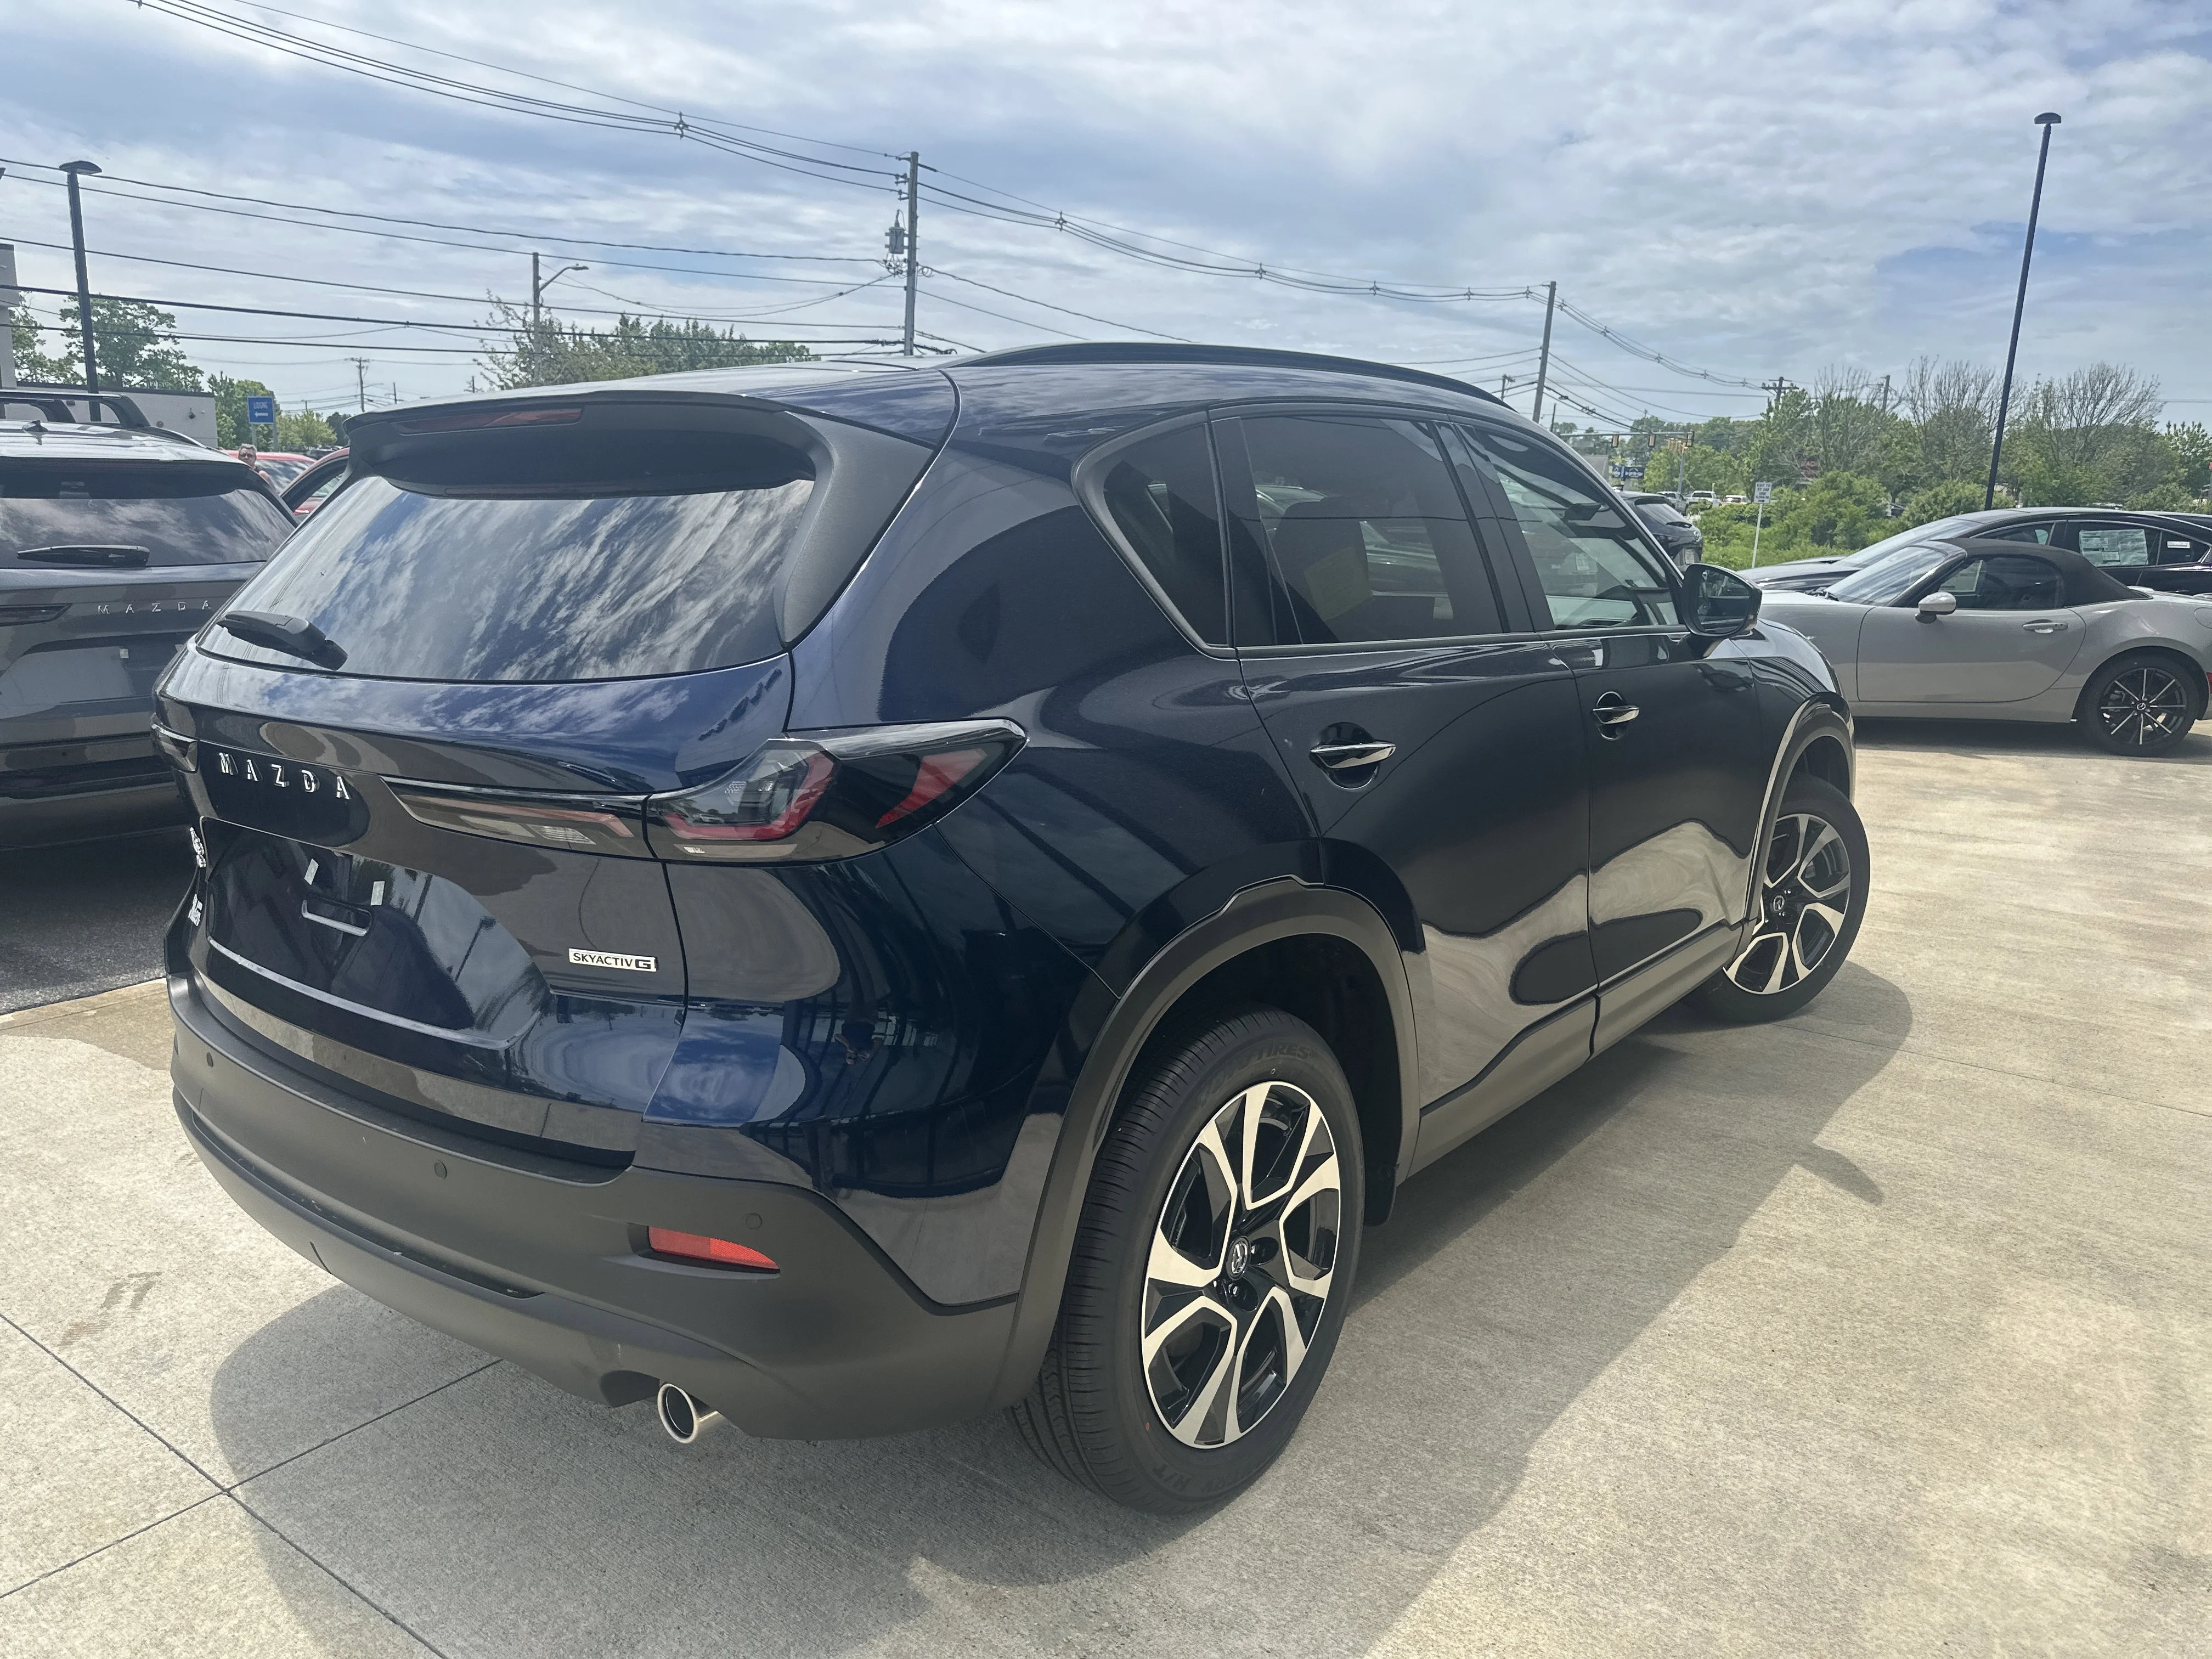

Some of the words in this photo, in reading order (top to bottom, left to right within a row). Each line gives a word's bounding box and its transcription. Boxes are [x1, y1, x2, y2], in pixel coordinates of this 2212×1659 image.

[97, 600, 212, 615] MAZDA
[218, 752, 352, 800] MAZDA
[1251, 1040, 1311, 1061] TIRES
